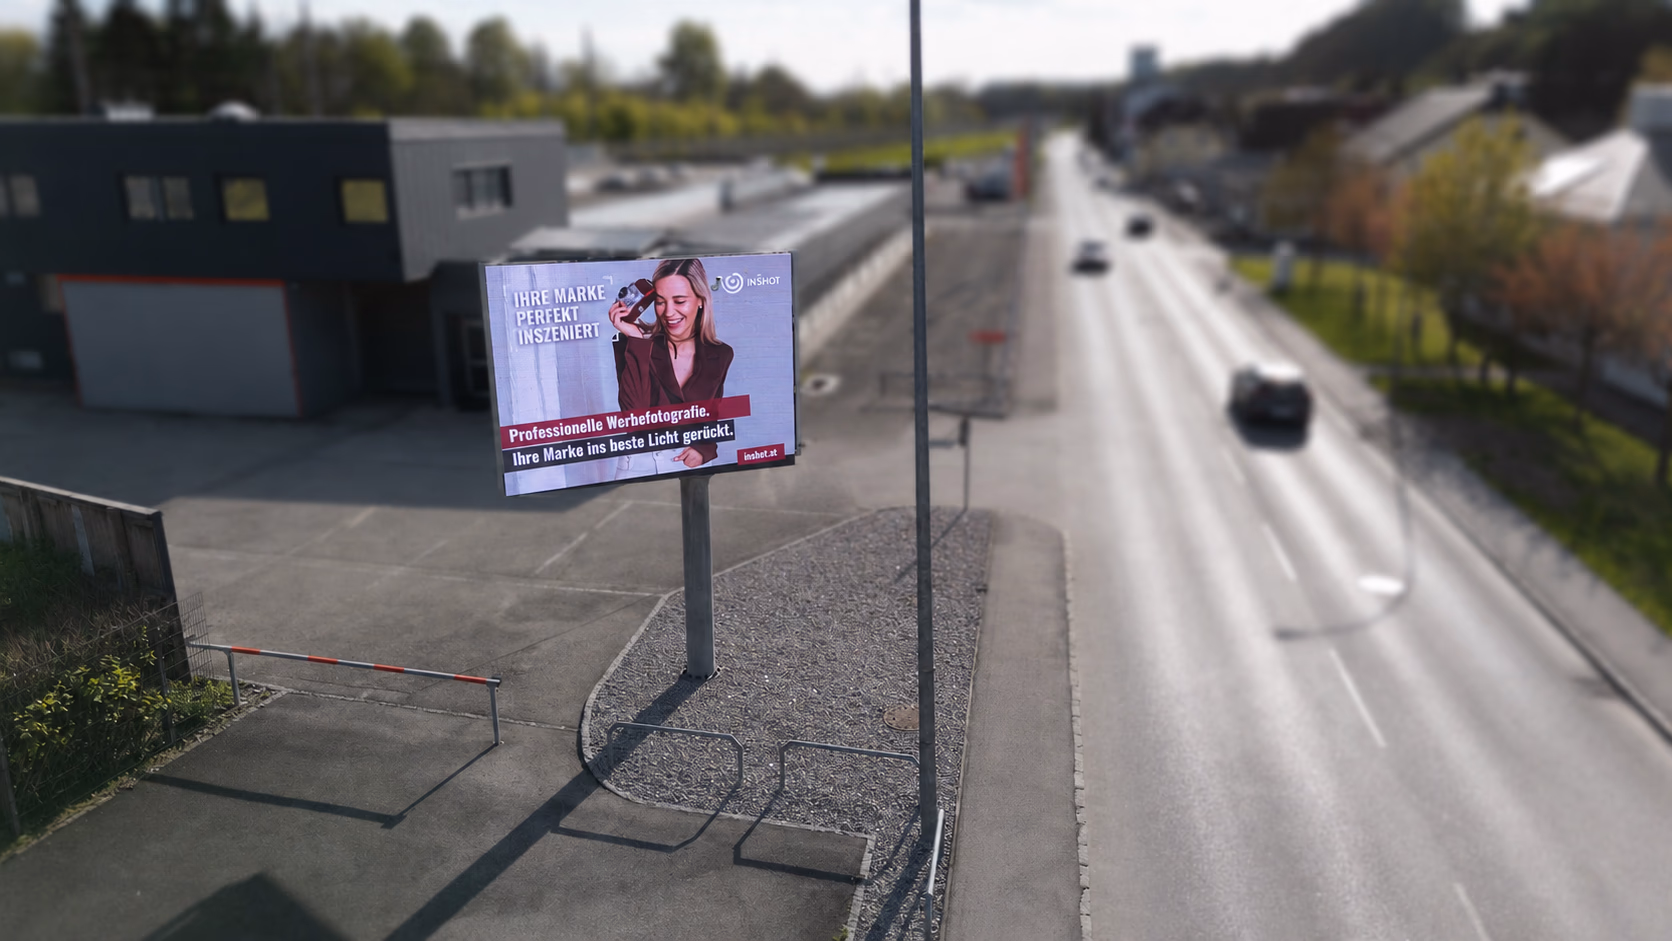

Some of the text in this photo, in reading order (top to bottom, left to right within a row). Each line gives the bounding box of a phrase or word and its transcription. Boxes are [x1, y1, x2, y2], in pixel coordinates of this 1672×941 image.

[514, 284, 606, 308] IHRE MARKE
[516, 306, 579, 327] PERFEKT
[518, 322, 600, 345] INSZENIERT
[509, 405, 710, 443] Professionelle Werbefotografie.
[512, 423, 734, 466] Ihre Marke ins beste Licht gerückt.
[744, 448, 778, 461] inshot.at
